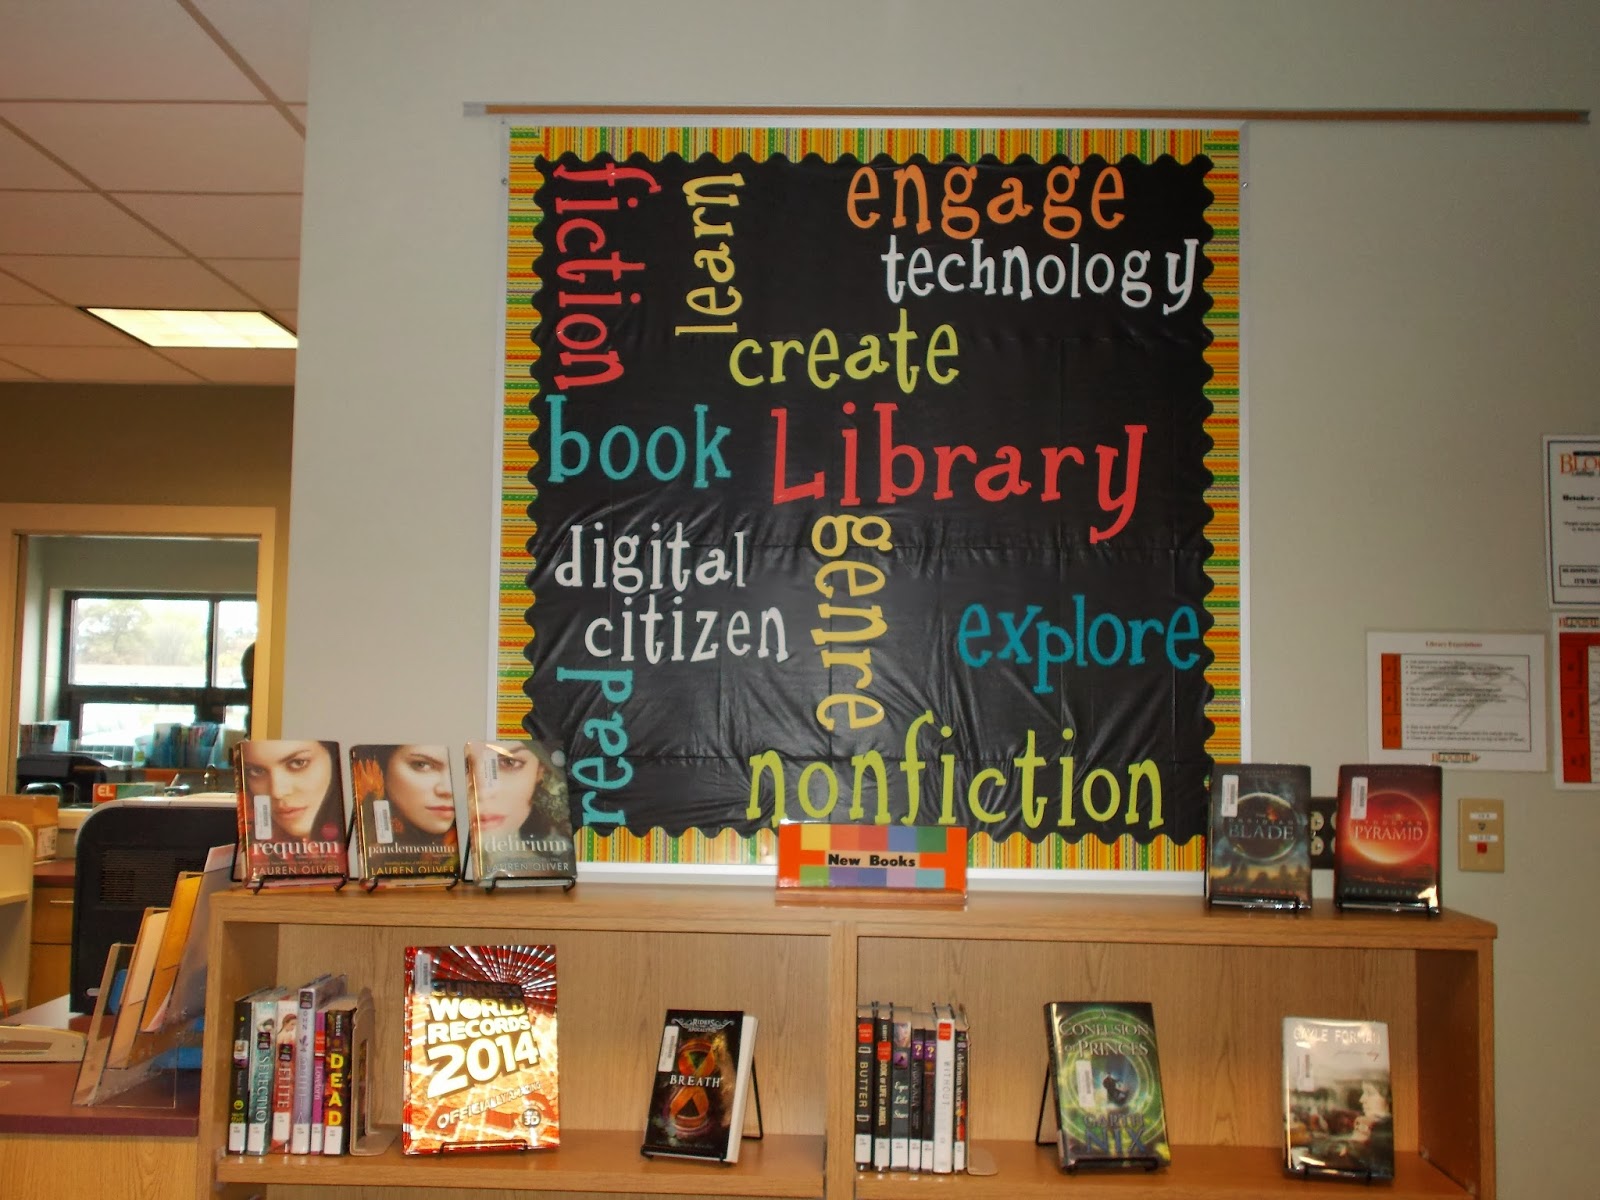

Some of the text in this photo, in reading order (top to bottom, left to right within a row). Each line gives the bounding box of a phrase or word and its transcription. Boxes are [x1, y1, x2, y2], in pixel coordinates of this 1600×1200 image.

[846, 163, 1126, 240] engage
[674, 172, 745, 336] learn
[880, 234, 1200, 315] technology
[553, 163, 662, 390] fiction
[729, 308, 960, 394] create
[546, 394, 732, 488] book
[770, 402, 1150, 544] Library
[554, 522, 748, 596] digital
[584, 595, 791, 666] citizen
[811, 514, 893, 731] genre
[956, 595, 1202, 694] explore
[557, 667, 633, 826] read
[746, 710, 1165, 826] nonfiction
[252, 838, 340, 860] requiem
[368, 841, 456, 858] pandemonium
[484, 834, 569, 852] delirium
[1228, 825, 1294, 840] BLADE
[1354, 825, 1423, 840] PYRAMID
[301, 865, 340, 874] OLIVER
[371, 865, 455, 875] LAUREN OLIVER
[486, 862, 570, 873] LAUREN OLIVER
[828, 853, 916, 867] New Books
[428, 1014, 531, 1045] RECORDS
[429, 997, 526, 1021] WORLD
[1059, 1022, 1150, 1037] CONFUSION
[427, 1031, 541, 1099] 2014
[1078, 1039, 1149, 1057] PRINCES
[255, 1055, 270, 1122] SELECTIO
[277, 1067, 292, 1108] ELITE
[328, 1053, 344, 1126] DEAD
[669, 1074, 721, 1088] BREATH
[858, 1061, 869, 1108] BUTTER
[436, 1093, 508, 1129] OFFICIALLY
[1085, 1126, 1147, 1154] NIX
